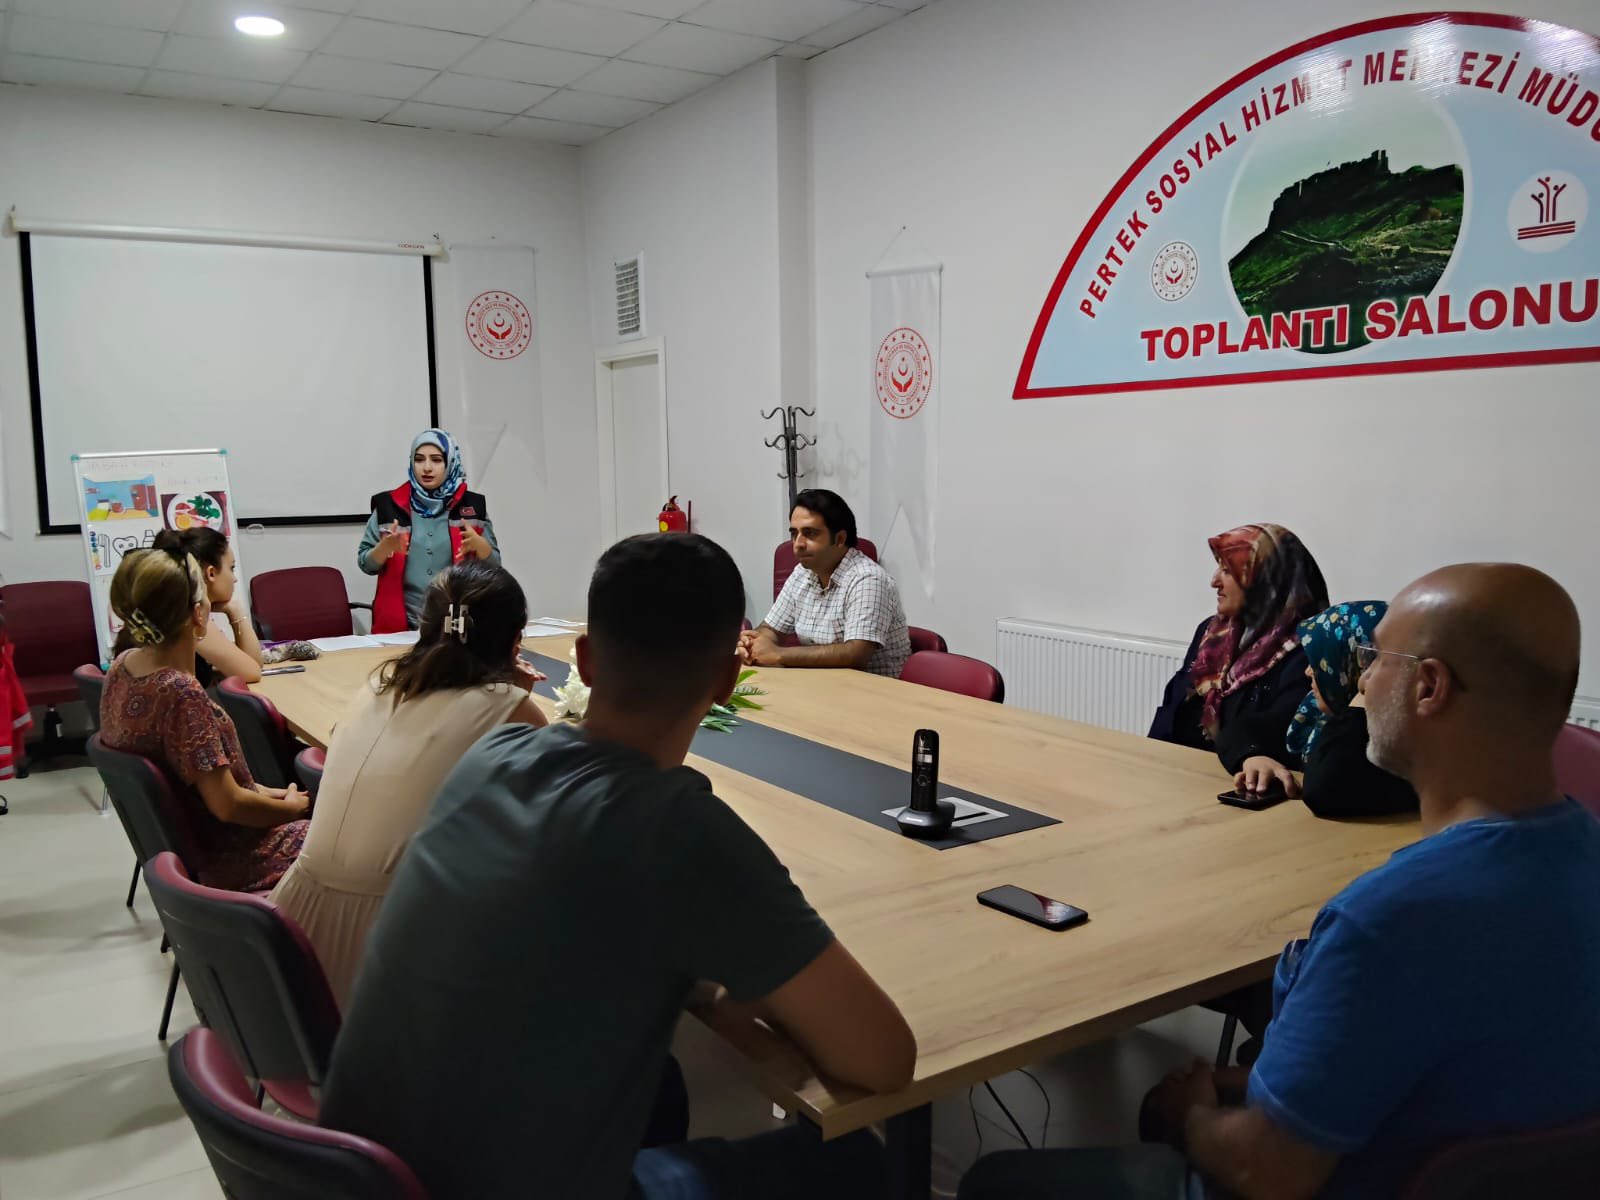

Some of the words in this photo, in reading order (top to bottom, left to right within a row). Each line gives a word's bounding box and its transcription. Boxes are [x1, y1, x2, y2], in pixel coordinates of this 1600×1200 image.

[1079, 210, 1149, 319] PERTEK
[1145, 121, 1237, 214] SOSYAL
[1241, 59, 1353, 132] HİZMT
[1363, 50, 1520, 93] MEEZİ
[1140, 305, 1350, 361] TOPLANTI
[1365, 279, 1599, 341] SALONU
